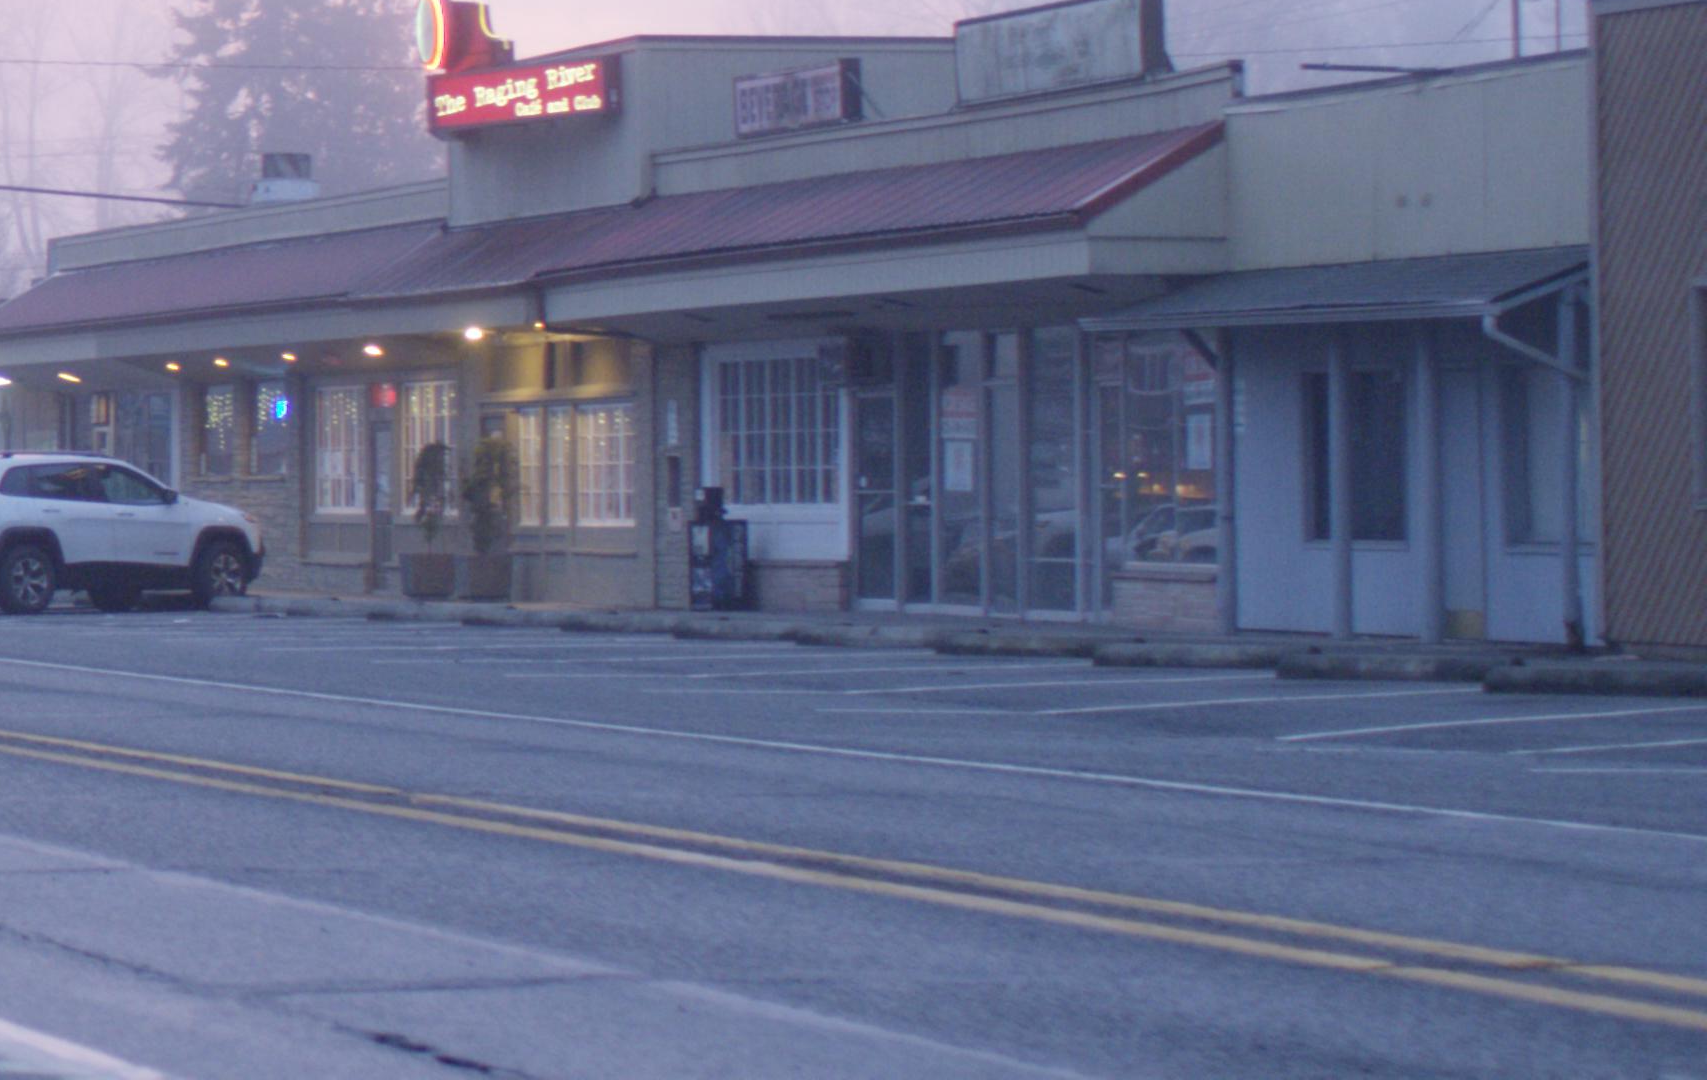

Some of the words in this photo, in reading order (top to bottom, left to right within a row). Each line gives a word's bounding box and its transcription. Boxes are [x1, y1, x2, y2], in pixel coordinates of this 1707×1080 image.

[434, 94, 467, 117] The
[473, 78, 539, 107] Raging
[545, 63, 596, 90] River
[546, 97, 570, 114] and
